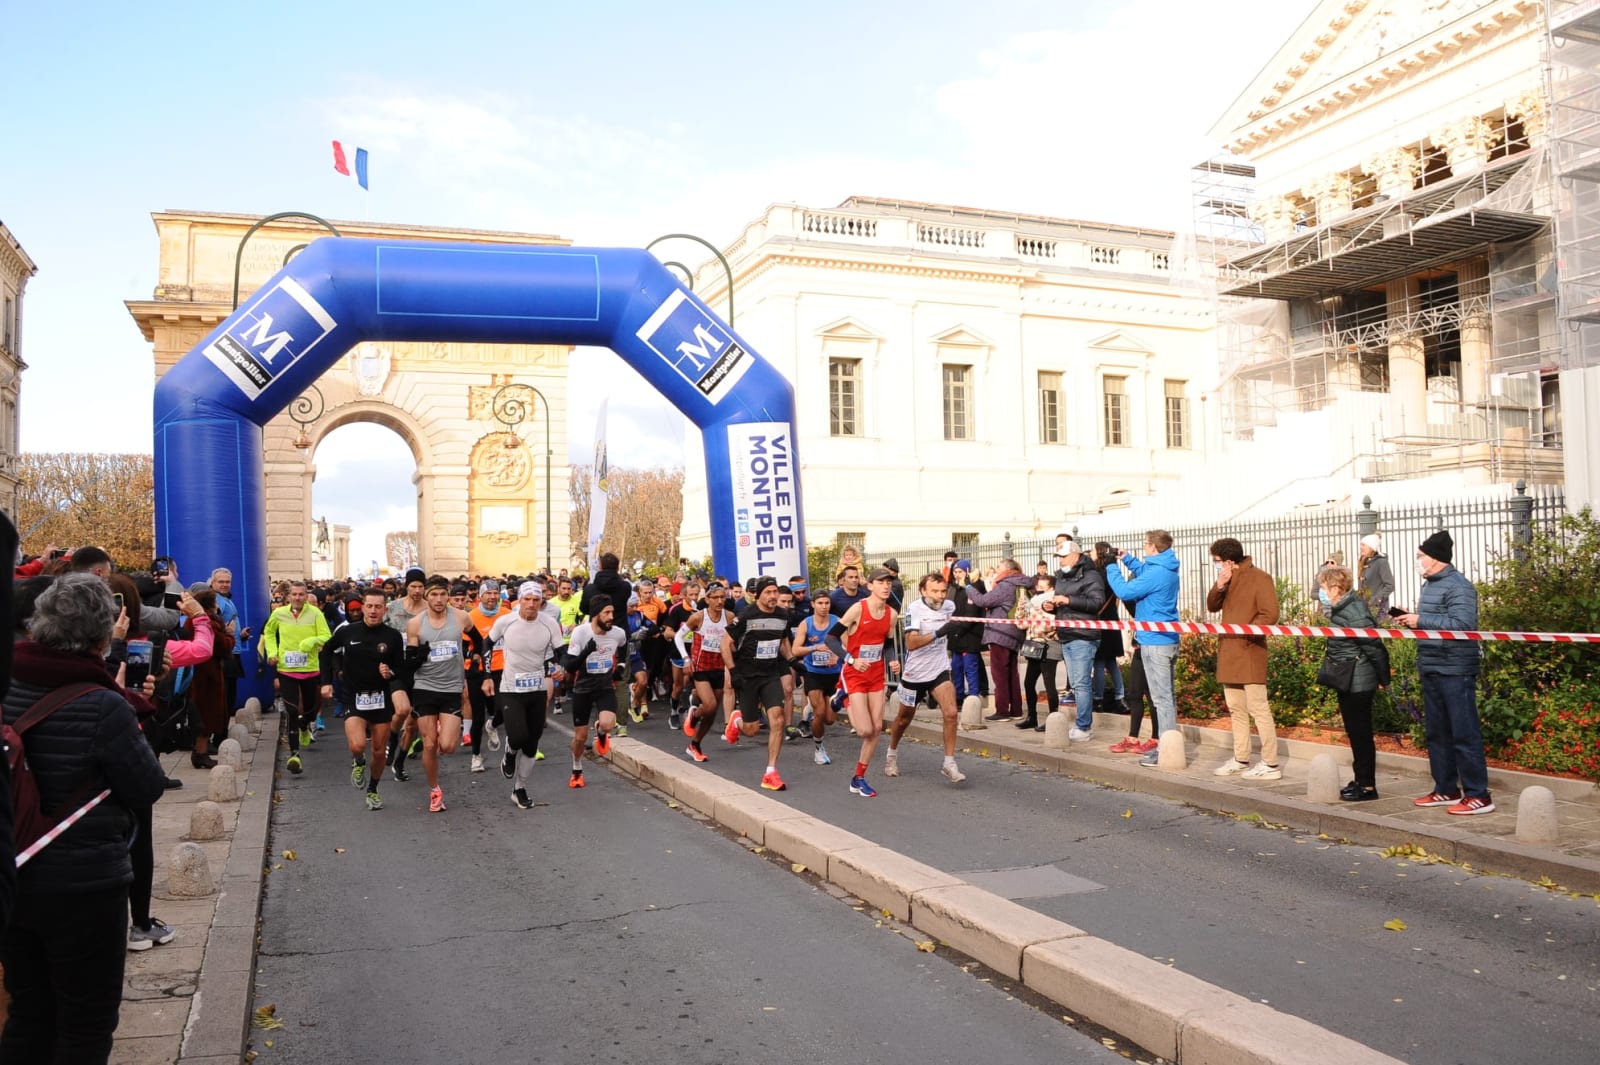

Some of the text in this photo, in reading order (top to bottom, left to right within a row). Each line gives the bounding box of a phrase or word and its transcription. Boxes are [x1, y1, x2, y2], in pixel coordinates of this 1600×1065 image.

[218, 337, 267, 385] Montpellier
[240, 312, 294, 365] M
[675, 323, 724, 371] M
[700, 347, 741, 391] Montpellier
[771, 435, 794, 550] VILLE DE
